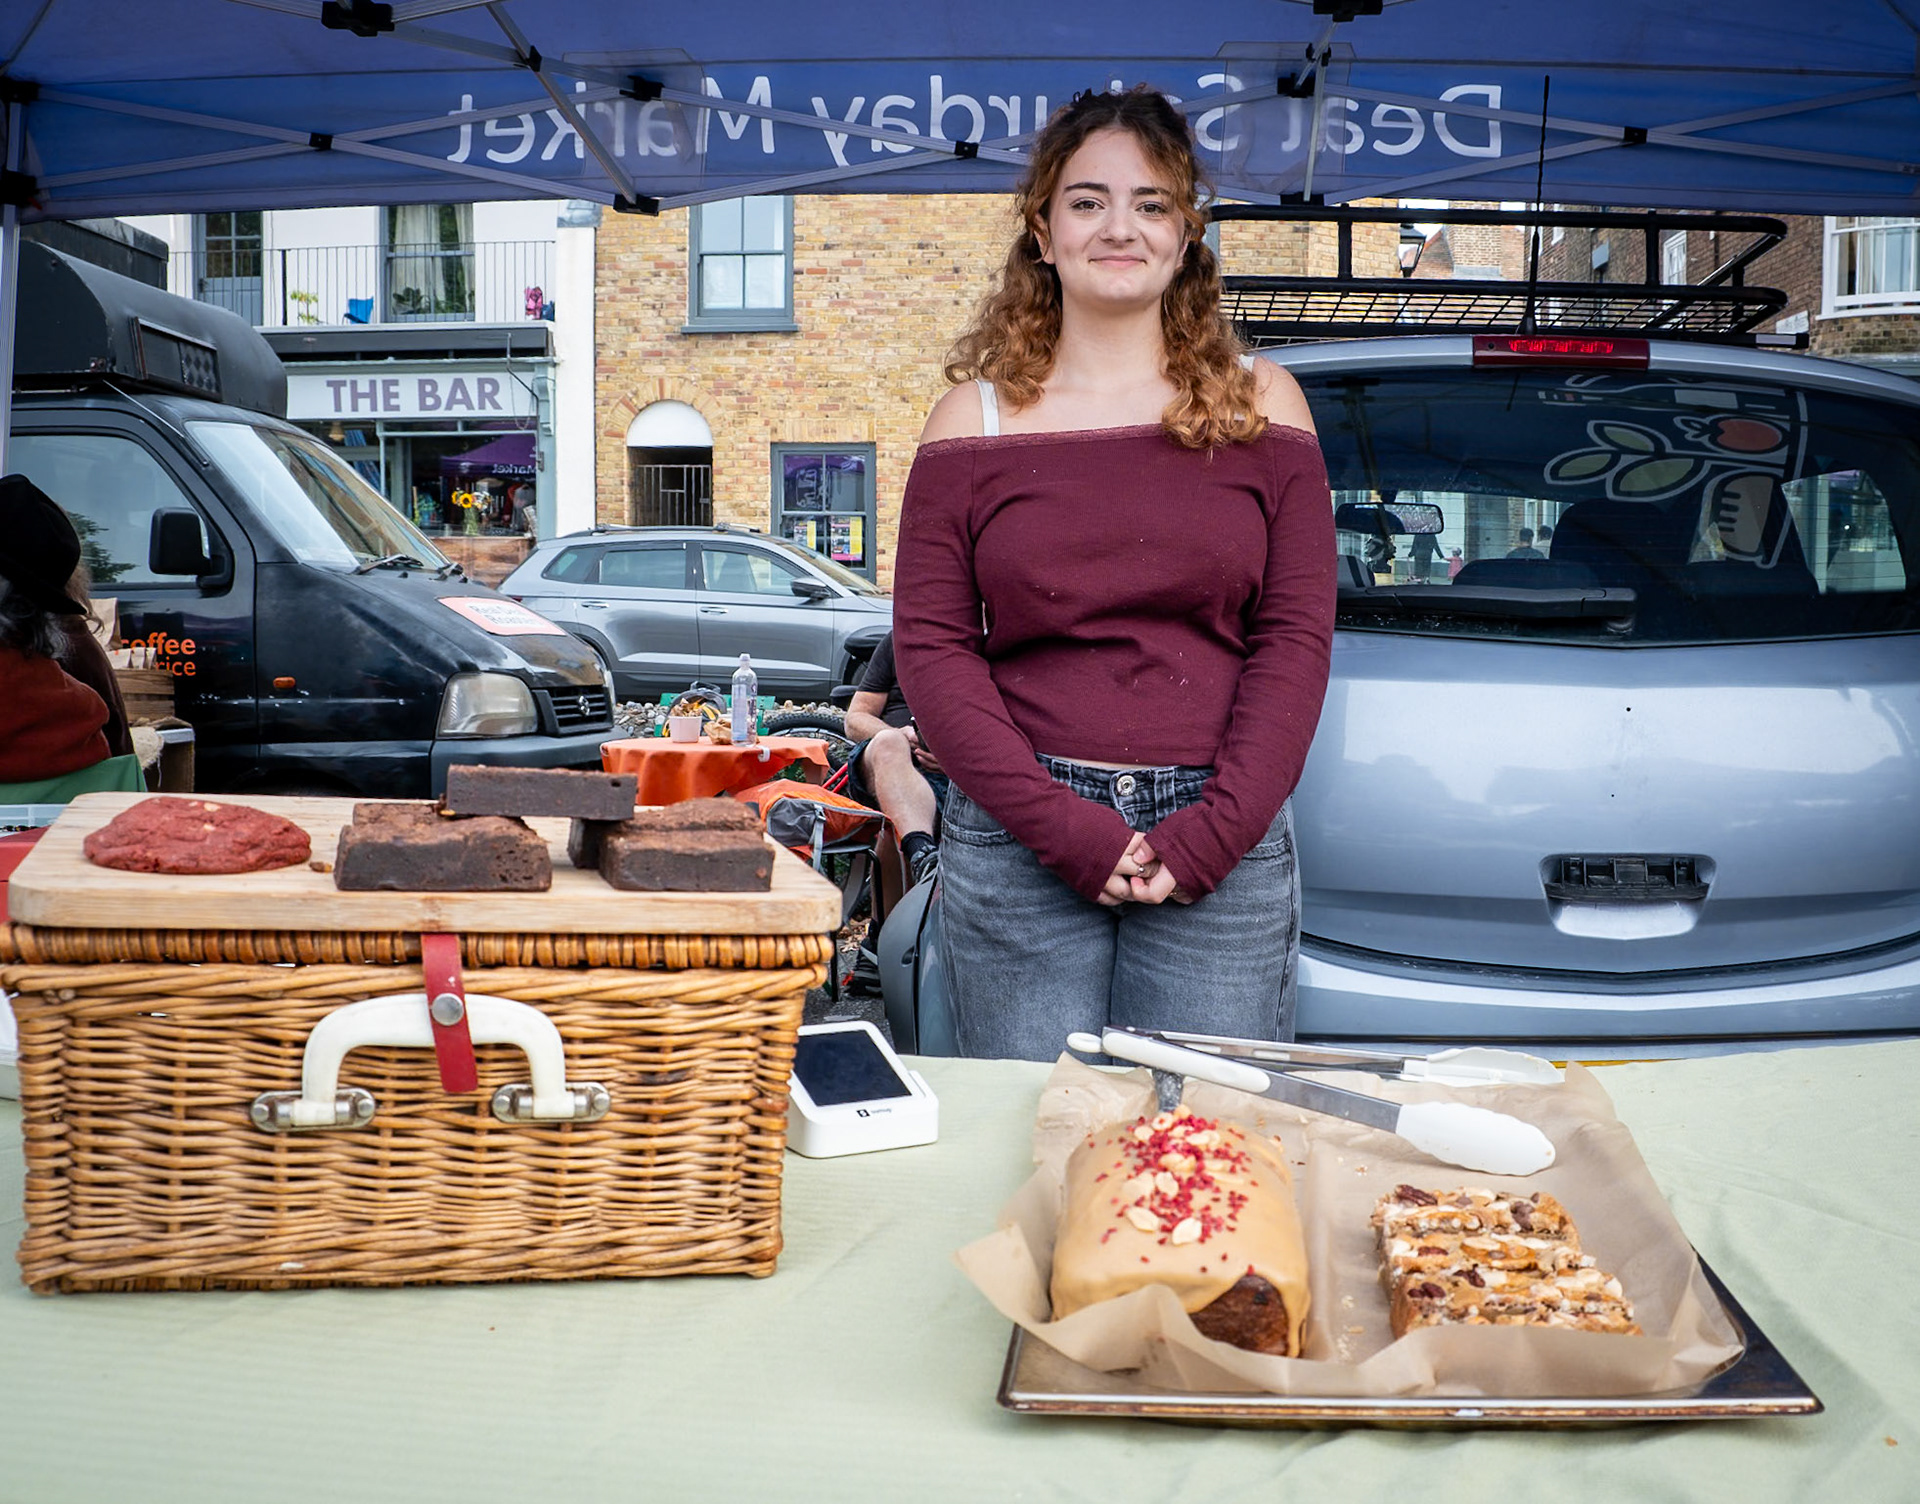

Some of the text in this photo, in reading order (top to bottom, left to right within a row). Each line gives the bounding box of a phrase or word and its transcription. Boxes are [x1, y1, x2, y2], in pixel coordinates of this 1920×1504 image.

[326, 377, 503, 413] THE BAR
[121, 632, 196, 655] offee
